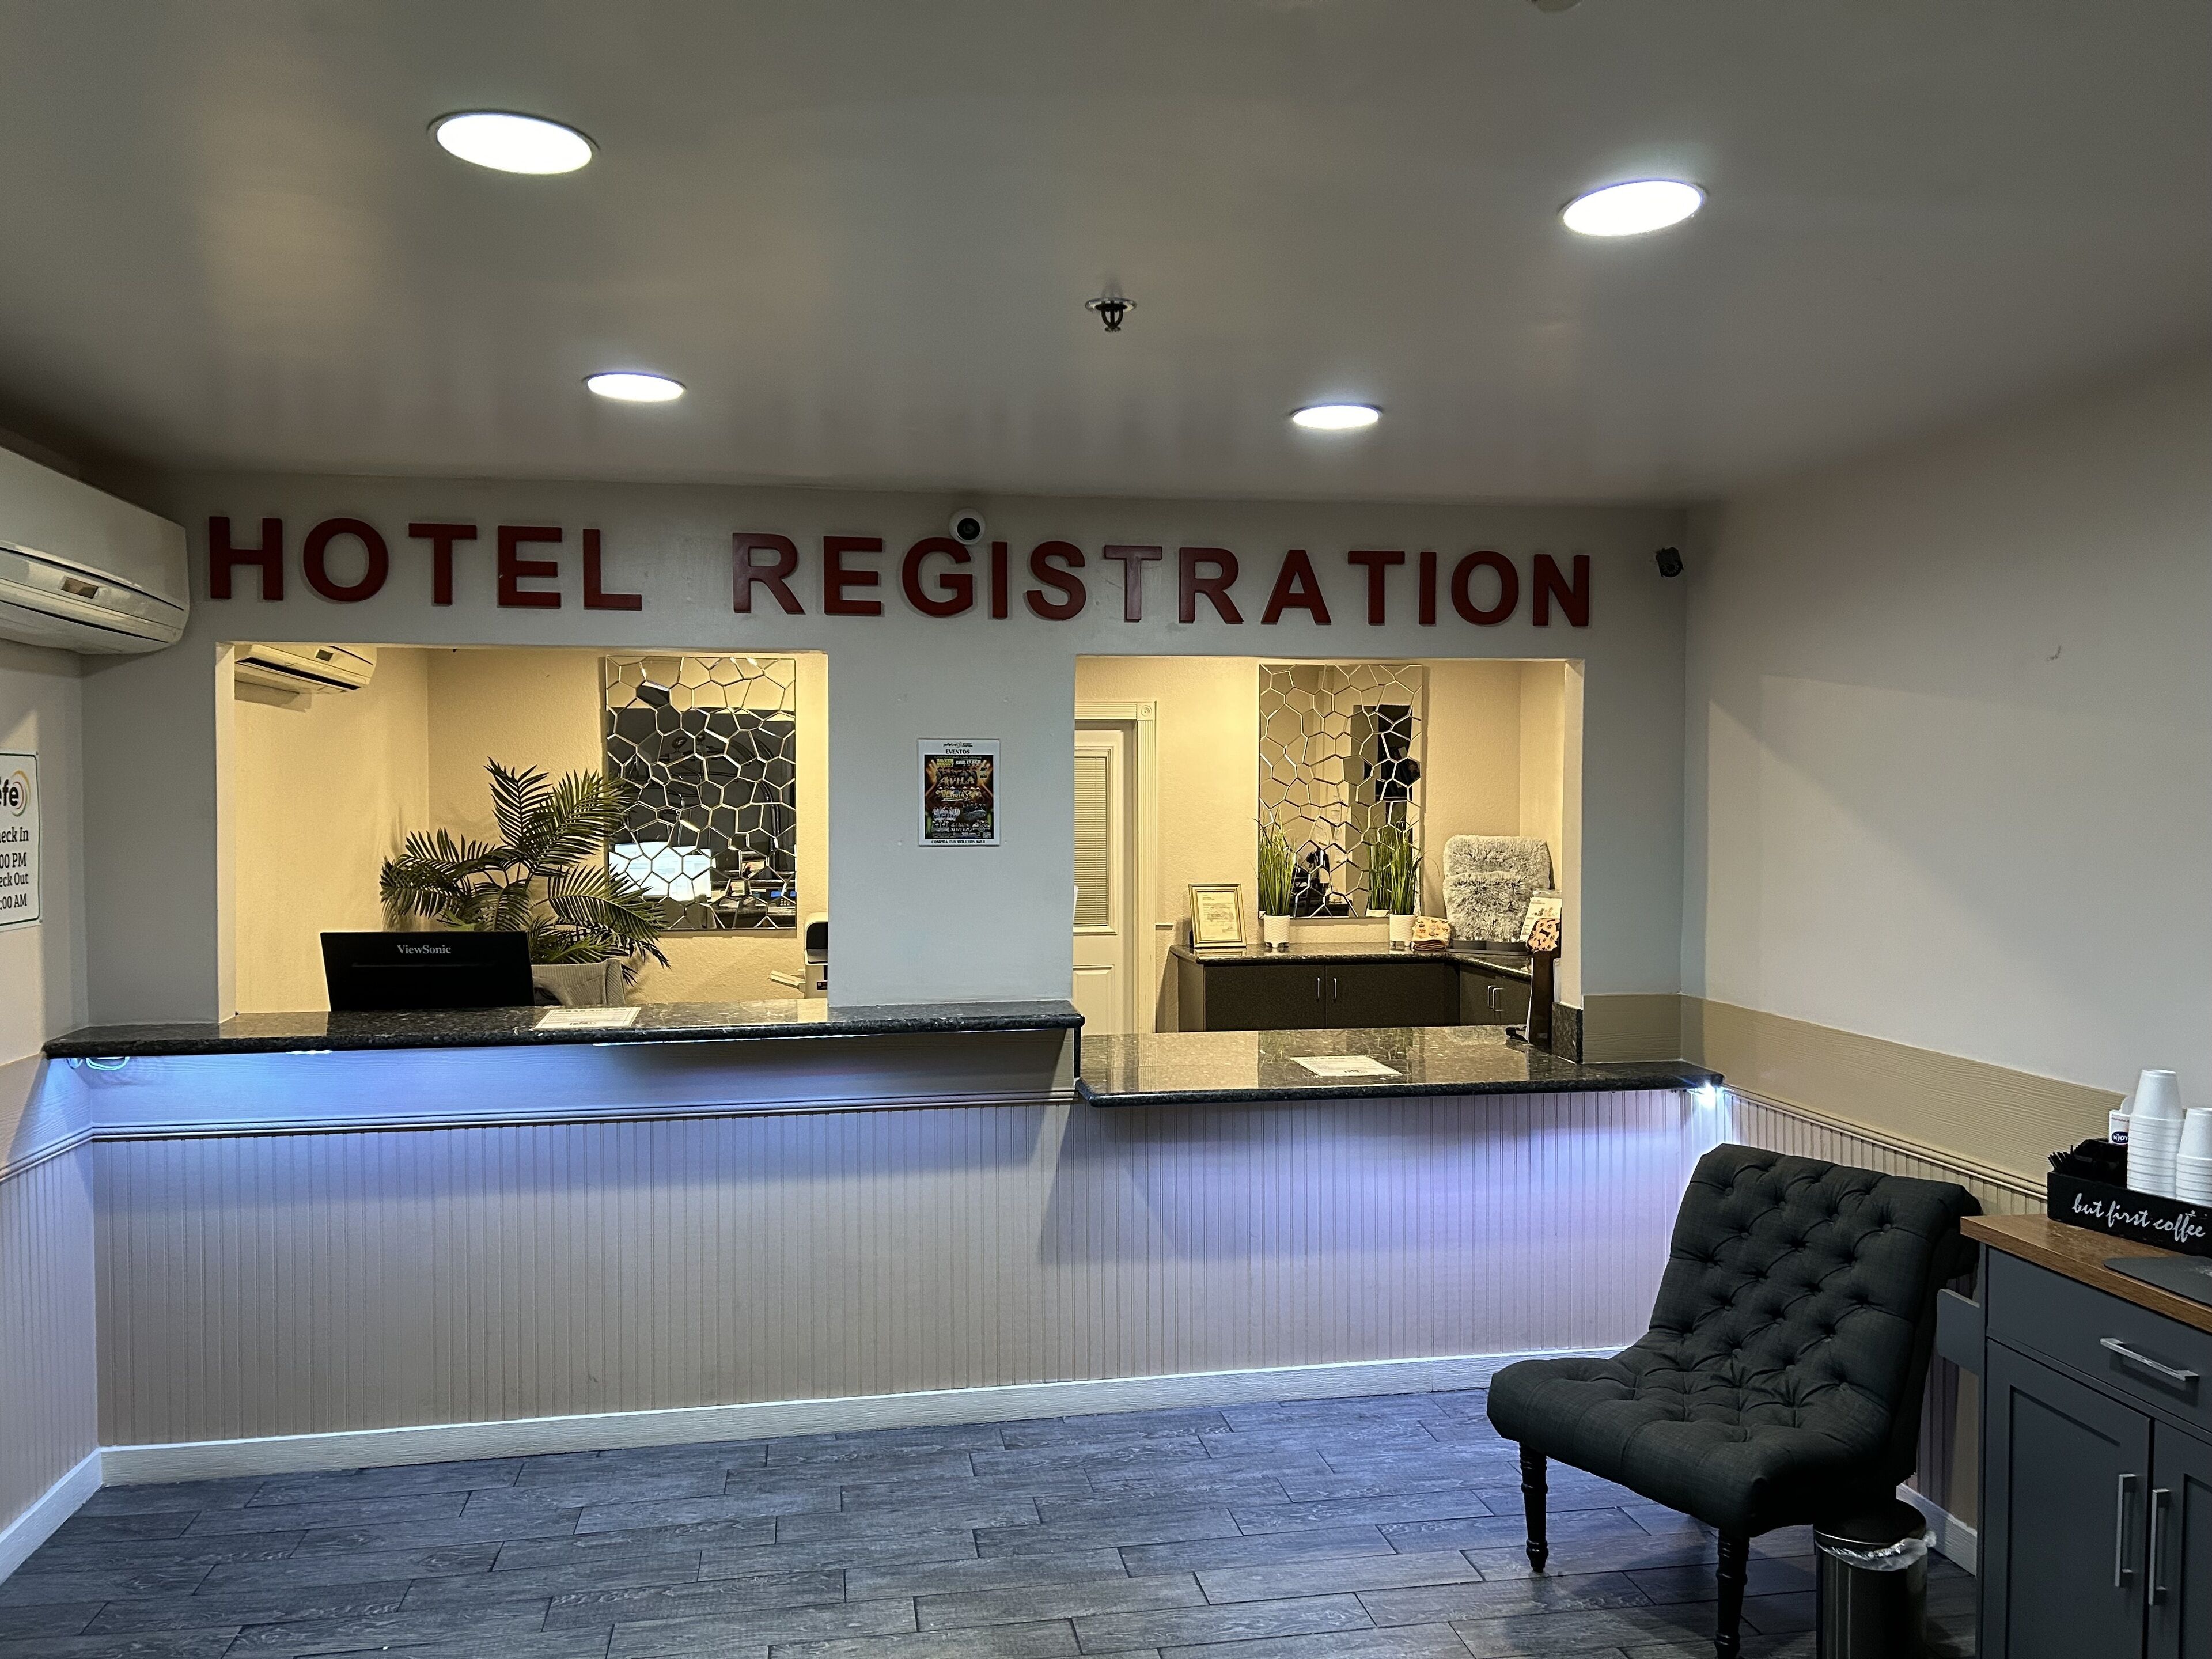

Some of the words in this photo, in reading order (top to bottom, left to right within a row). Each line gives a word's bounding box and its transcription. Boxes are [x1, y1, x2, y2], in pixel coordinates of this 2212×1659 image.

[209, 516, 643, 611] HOTEL
[732, 532, 1591, 627] REGISTRATION
[19, 827, 29, 842] In
[12, 851, 27, 868] PM
[14, 872, 29, 886] Out
[14, 893, 27, 908] AM
[396, 945, 452, 954] ViewSonic
[2072, 1192, 2104, 1217] but
[2107, 1200, 2150, 1228] first
[2152, 1211, 2206, 1243] coffee
